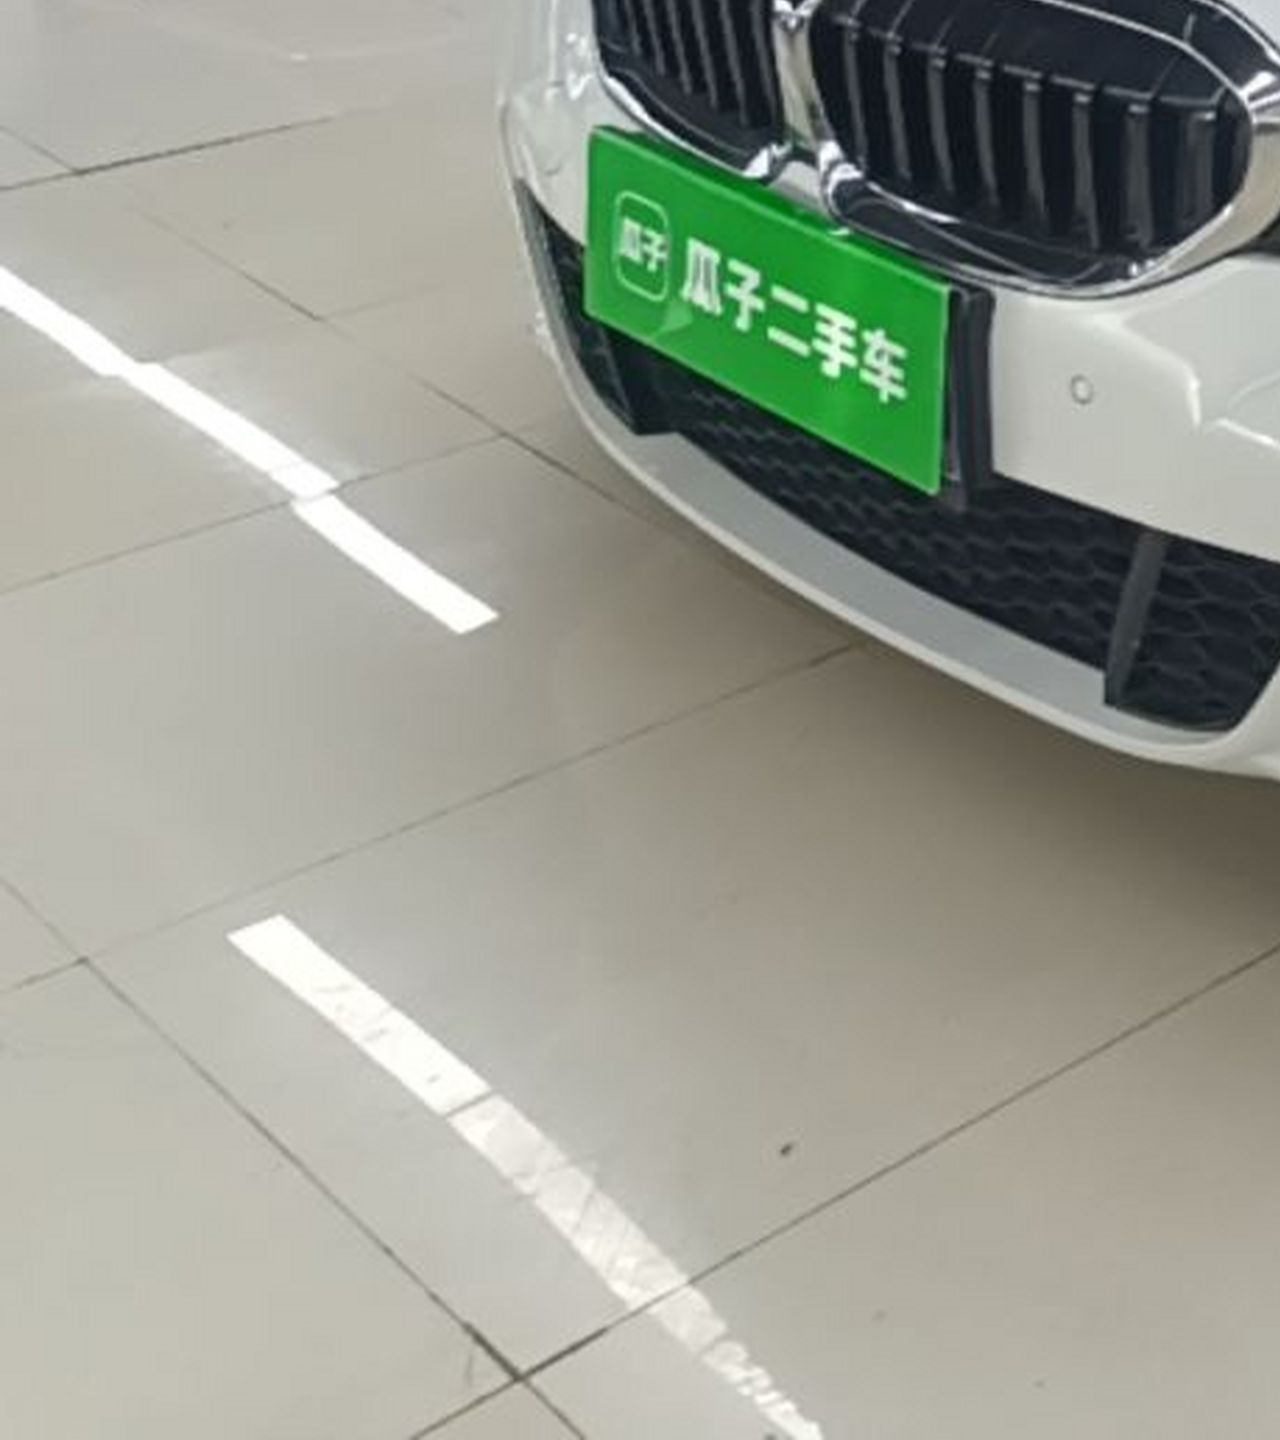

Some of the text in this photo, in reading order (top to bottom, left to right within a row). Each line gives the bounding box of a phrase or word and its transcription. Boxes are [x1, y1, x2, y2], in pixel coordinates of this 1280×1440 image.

[618, 218, 667, 272] 瓜子
[680, 237, 907, 403] 瓜子二手车
